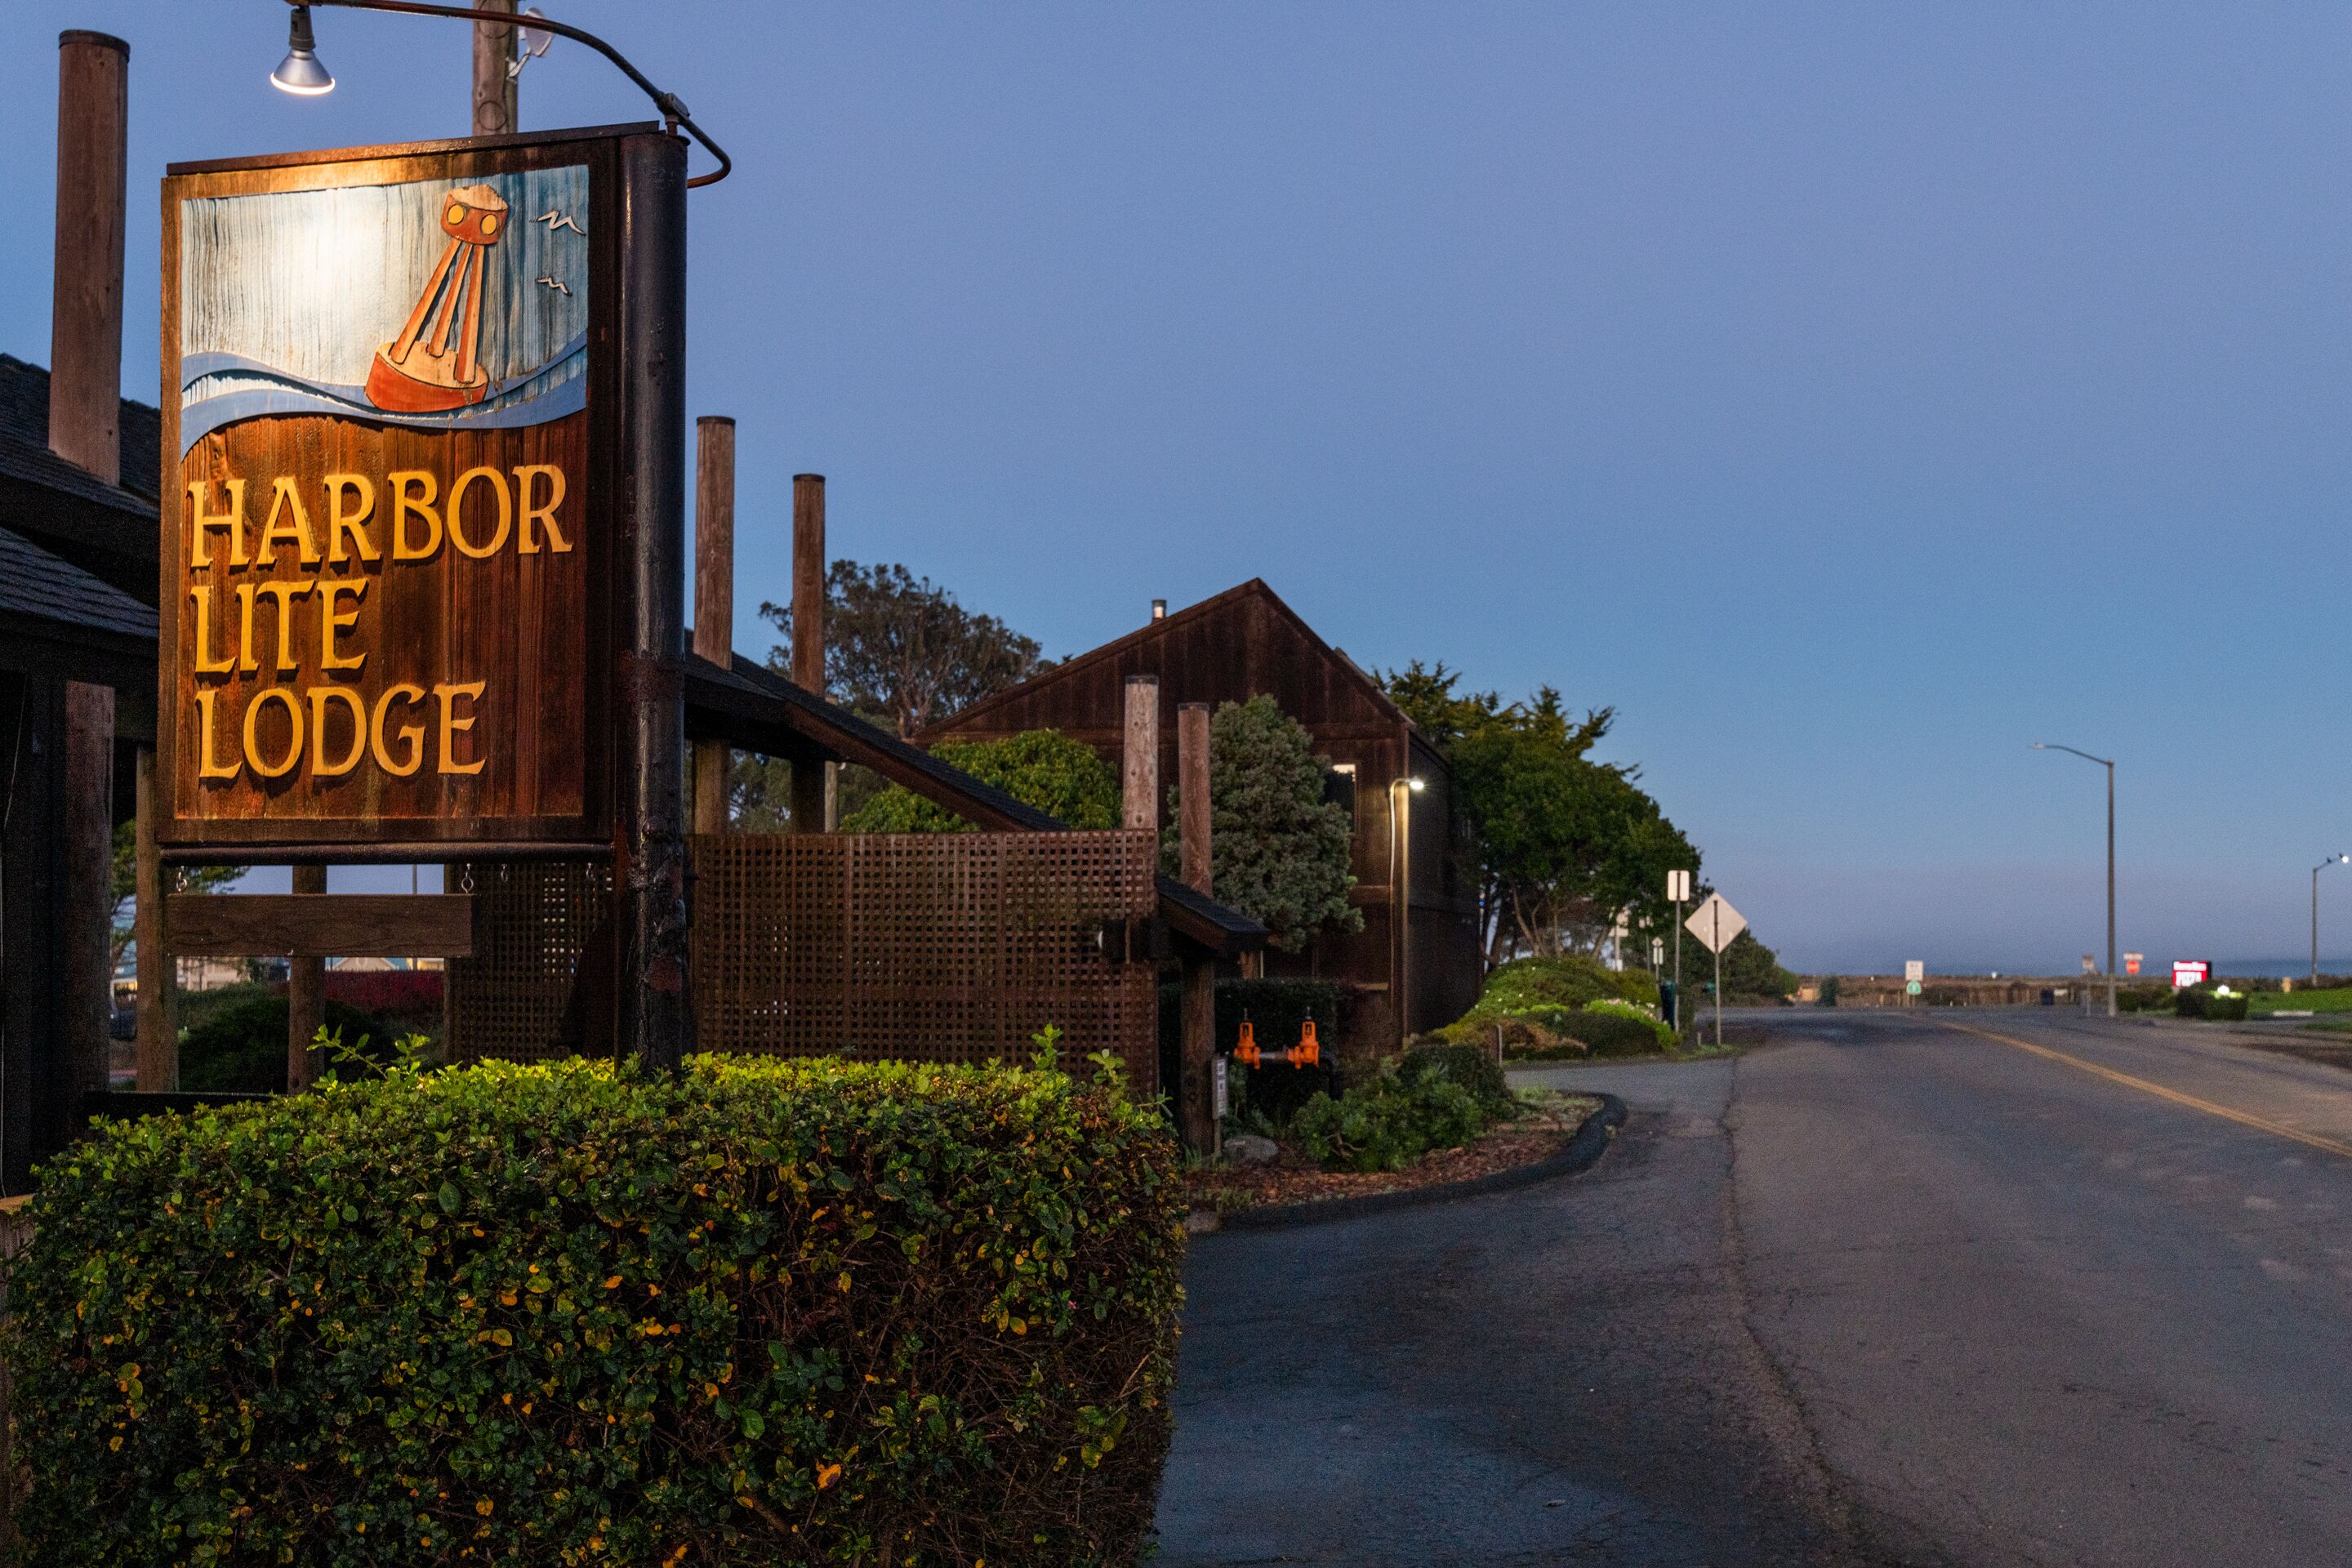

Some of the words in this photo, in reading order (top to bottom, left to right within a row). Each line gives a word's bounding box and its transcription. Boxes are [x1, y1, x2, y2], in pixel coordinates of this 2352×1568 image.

[187, 466, 573, 568] HARBOR
[190, 579, 369, 674] LITE
[195, 681, 488, 779] LODGE
